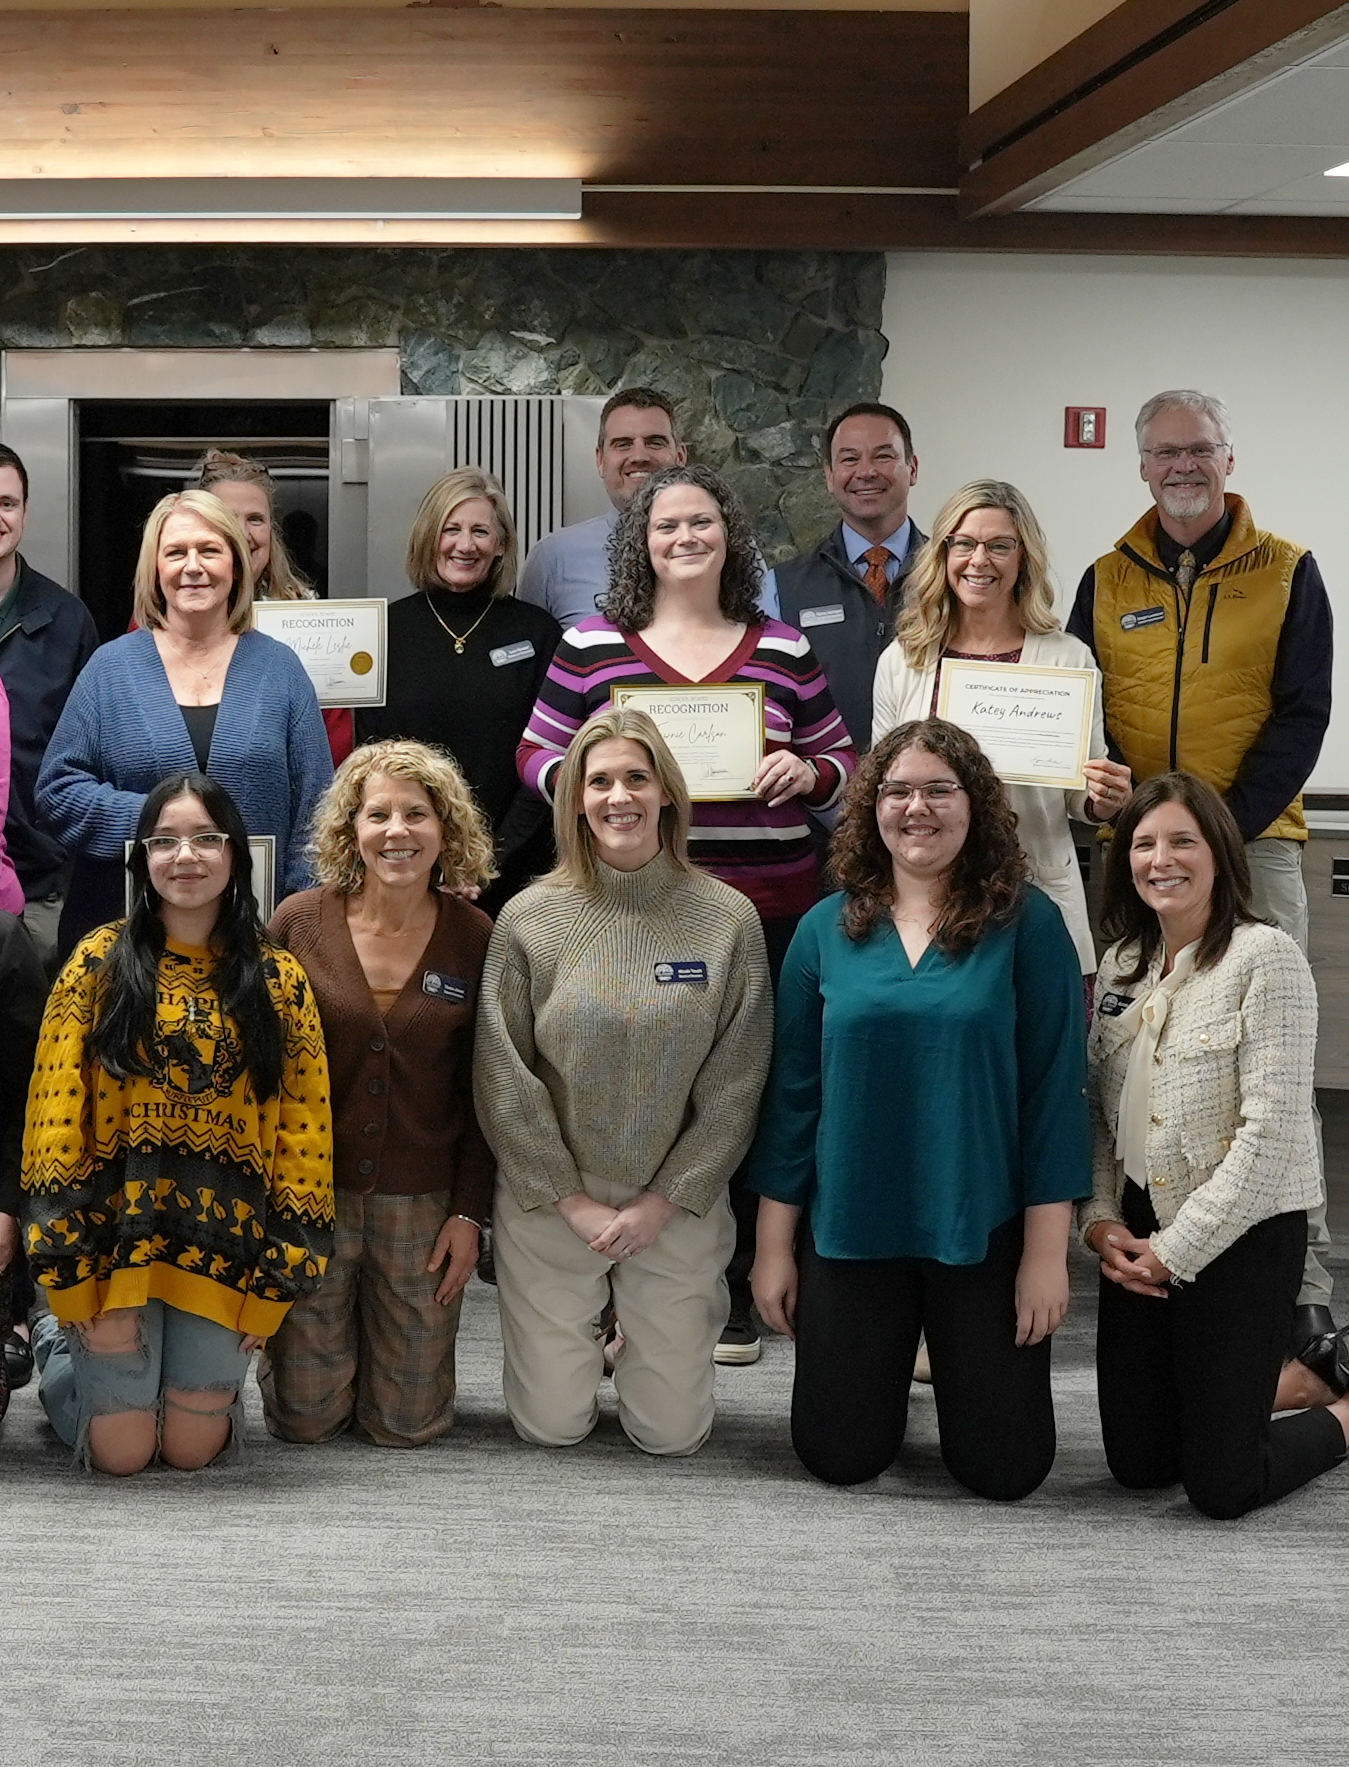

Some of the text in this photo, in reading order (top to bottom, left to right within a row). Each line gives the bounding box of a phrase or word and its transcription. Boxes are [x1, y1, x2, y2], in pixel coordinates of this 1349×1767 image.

[281, 617, 355, 629] RECOGNITION
[964, 683, 1007, 693] CERTIFICATE
[1019, 687, 1071, 697] APPRECIATION
[649, 703, 729, 714] RECOGNITION
[970, 700, 1063, 721] Katey Andrews
[130, 1102, 247, 1135] CHRISTMAS
